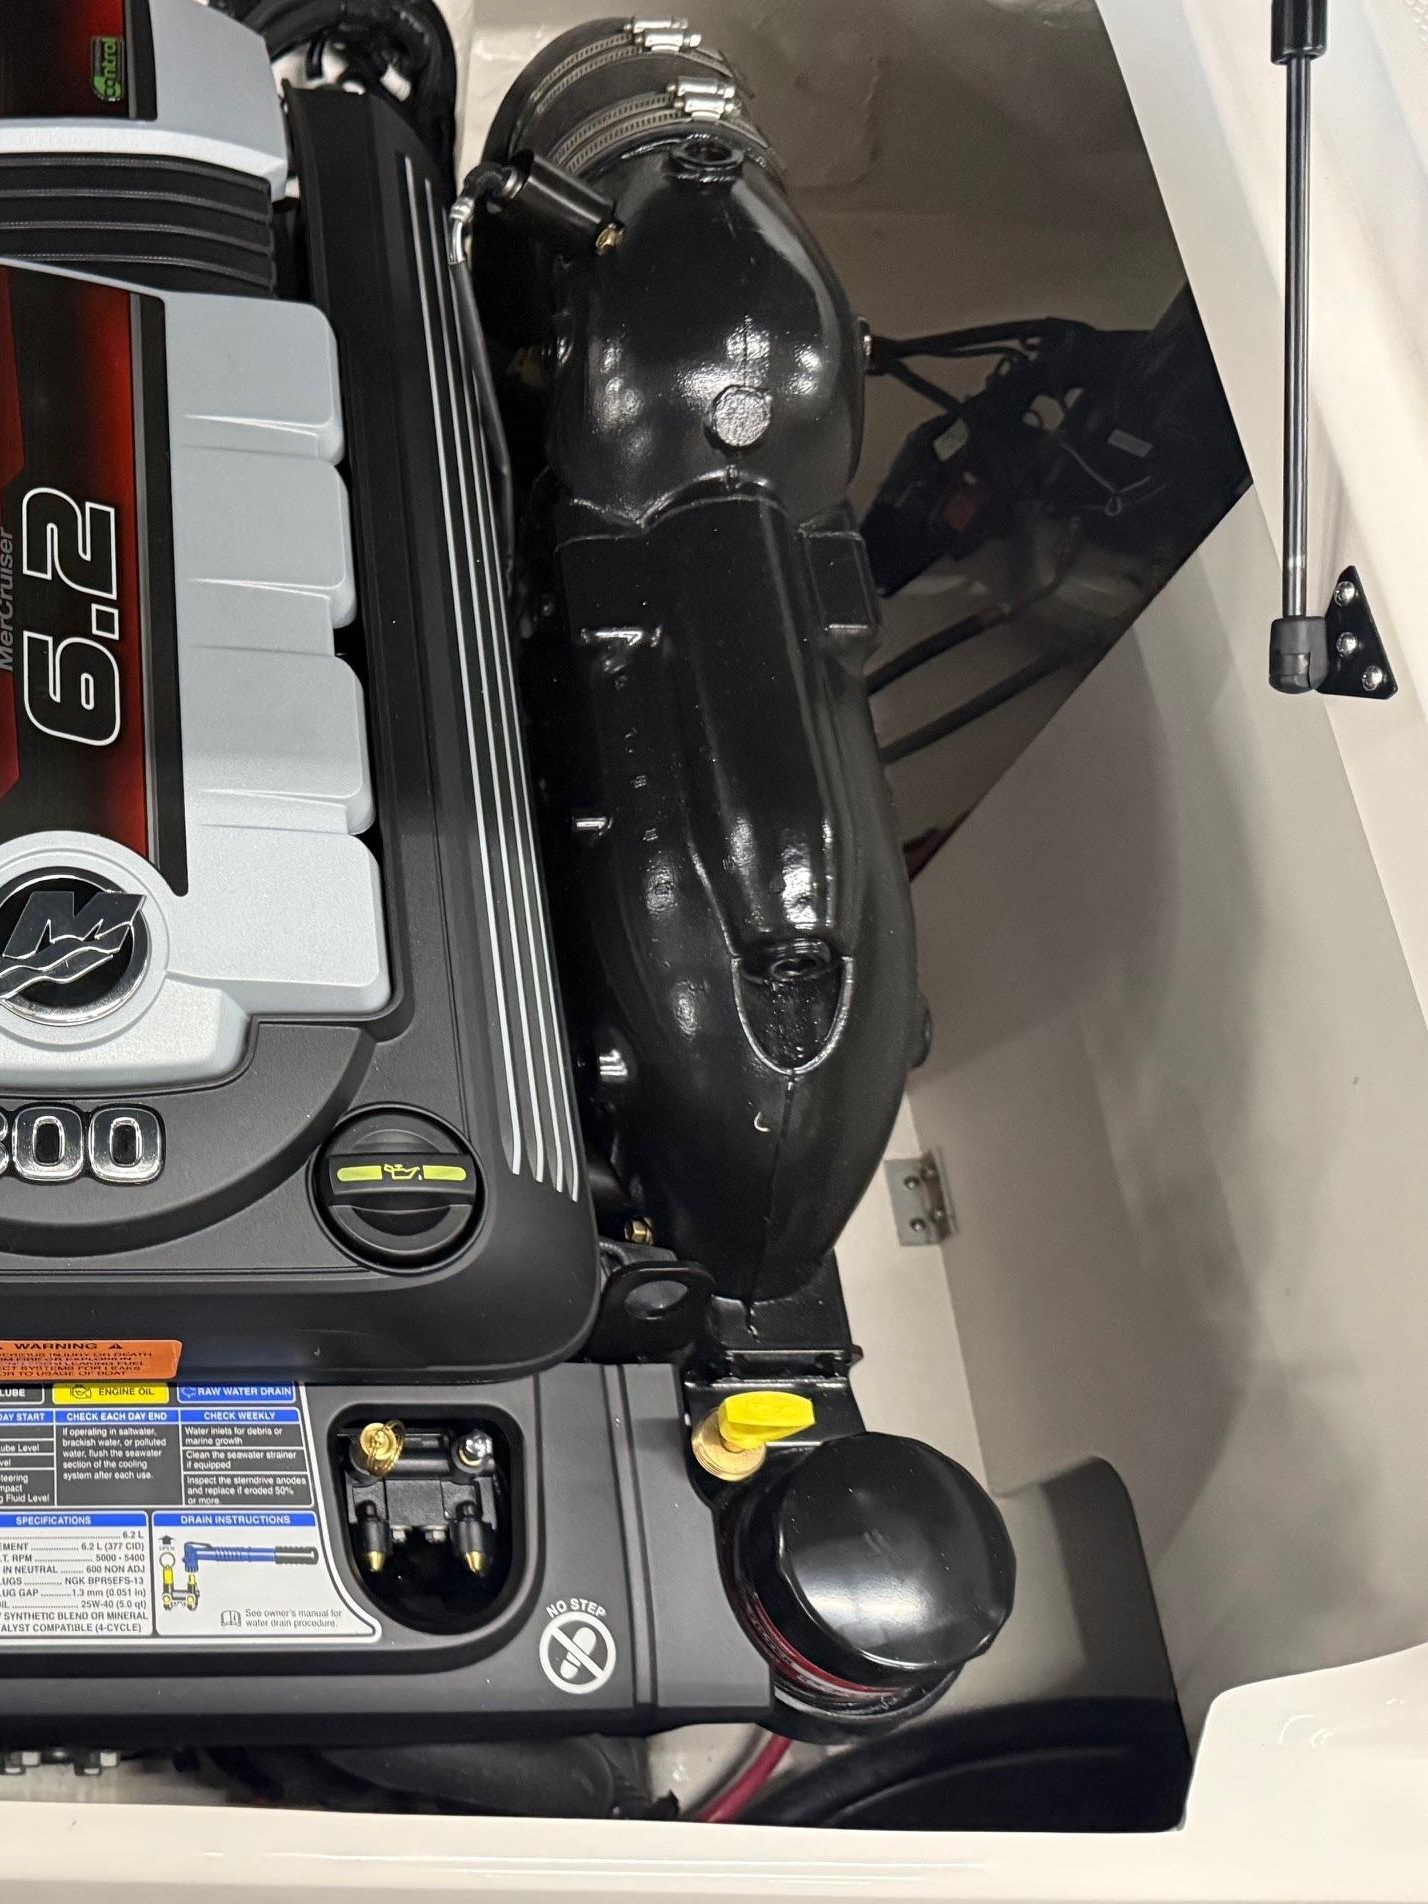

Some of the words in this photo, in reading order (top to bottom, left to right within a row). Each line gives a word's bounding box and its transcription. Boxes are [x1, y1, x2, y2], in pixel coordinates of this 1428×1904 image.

[22, 487, 120, 746] 6.2
[0, 1388, 25, 1397] LUBE
[99, 1387, 135, 1395] ENGINE
[139, 1387, 154, 1395] OIL
[198, 1387, 220, 1395] RAW
[223, 1387, 257, 1395] WATER
[261, 1387, 291, 1395] DRAIN
[17, 1413, 45, 1421] START
[204, 1412, 235, 1420] CHECK
[238, 1412, 275, 1420] WEEKLY
[185, 1427, 208, 1435] Water
[215, 1437, 242, 1446] growth
[6, 1494, 25, 1503] Fluid
[28, 1494, 49, 1502] Level
[16, 1517, 91, 1525] SPECIFICATIONS
[181, 1516, 212, 1524] DRAIN
[216, 1515, 291, 1524] INSTRUCTIONS
[105, 1543, 122, 1551] (377
[125, 1543, 144, 1551] CID)
[12, 1554, 32, 1562] RPM
[106, 1589, 131, 1598] (0.051
[135, 1588, 146, 1597] in)
[117, 1600, 132, 1609] (5.0
[135, 1600, 146, 1609] qt)
[546, 1600, 568, 1617] NO
[570, 1598, 606, 1616] STEP
[4, 1612, 55, 1620] SYNTHETIC
[58, 1612, 88, 1620] BLEND
[91, 1612, 104, 1620] OR
[246, 1609, 261, 1617] See
[264, 1609, 296, 1617] owner's
[33, 1624, 92, 1632] COMPATIBLE
[95, 1624, 141, 1632] (4-CYCLE)
[294, 1620, 337, 1628] procedure.
